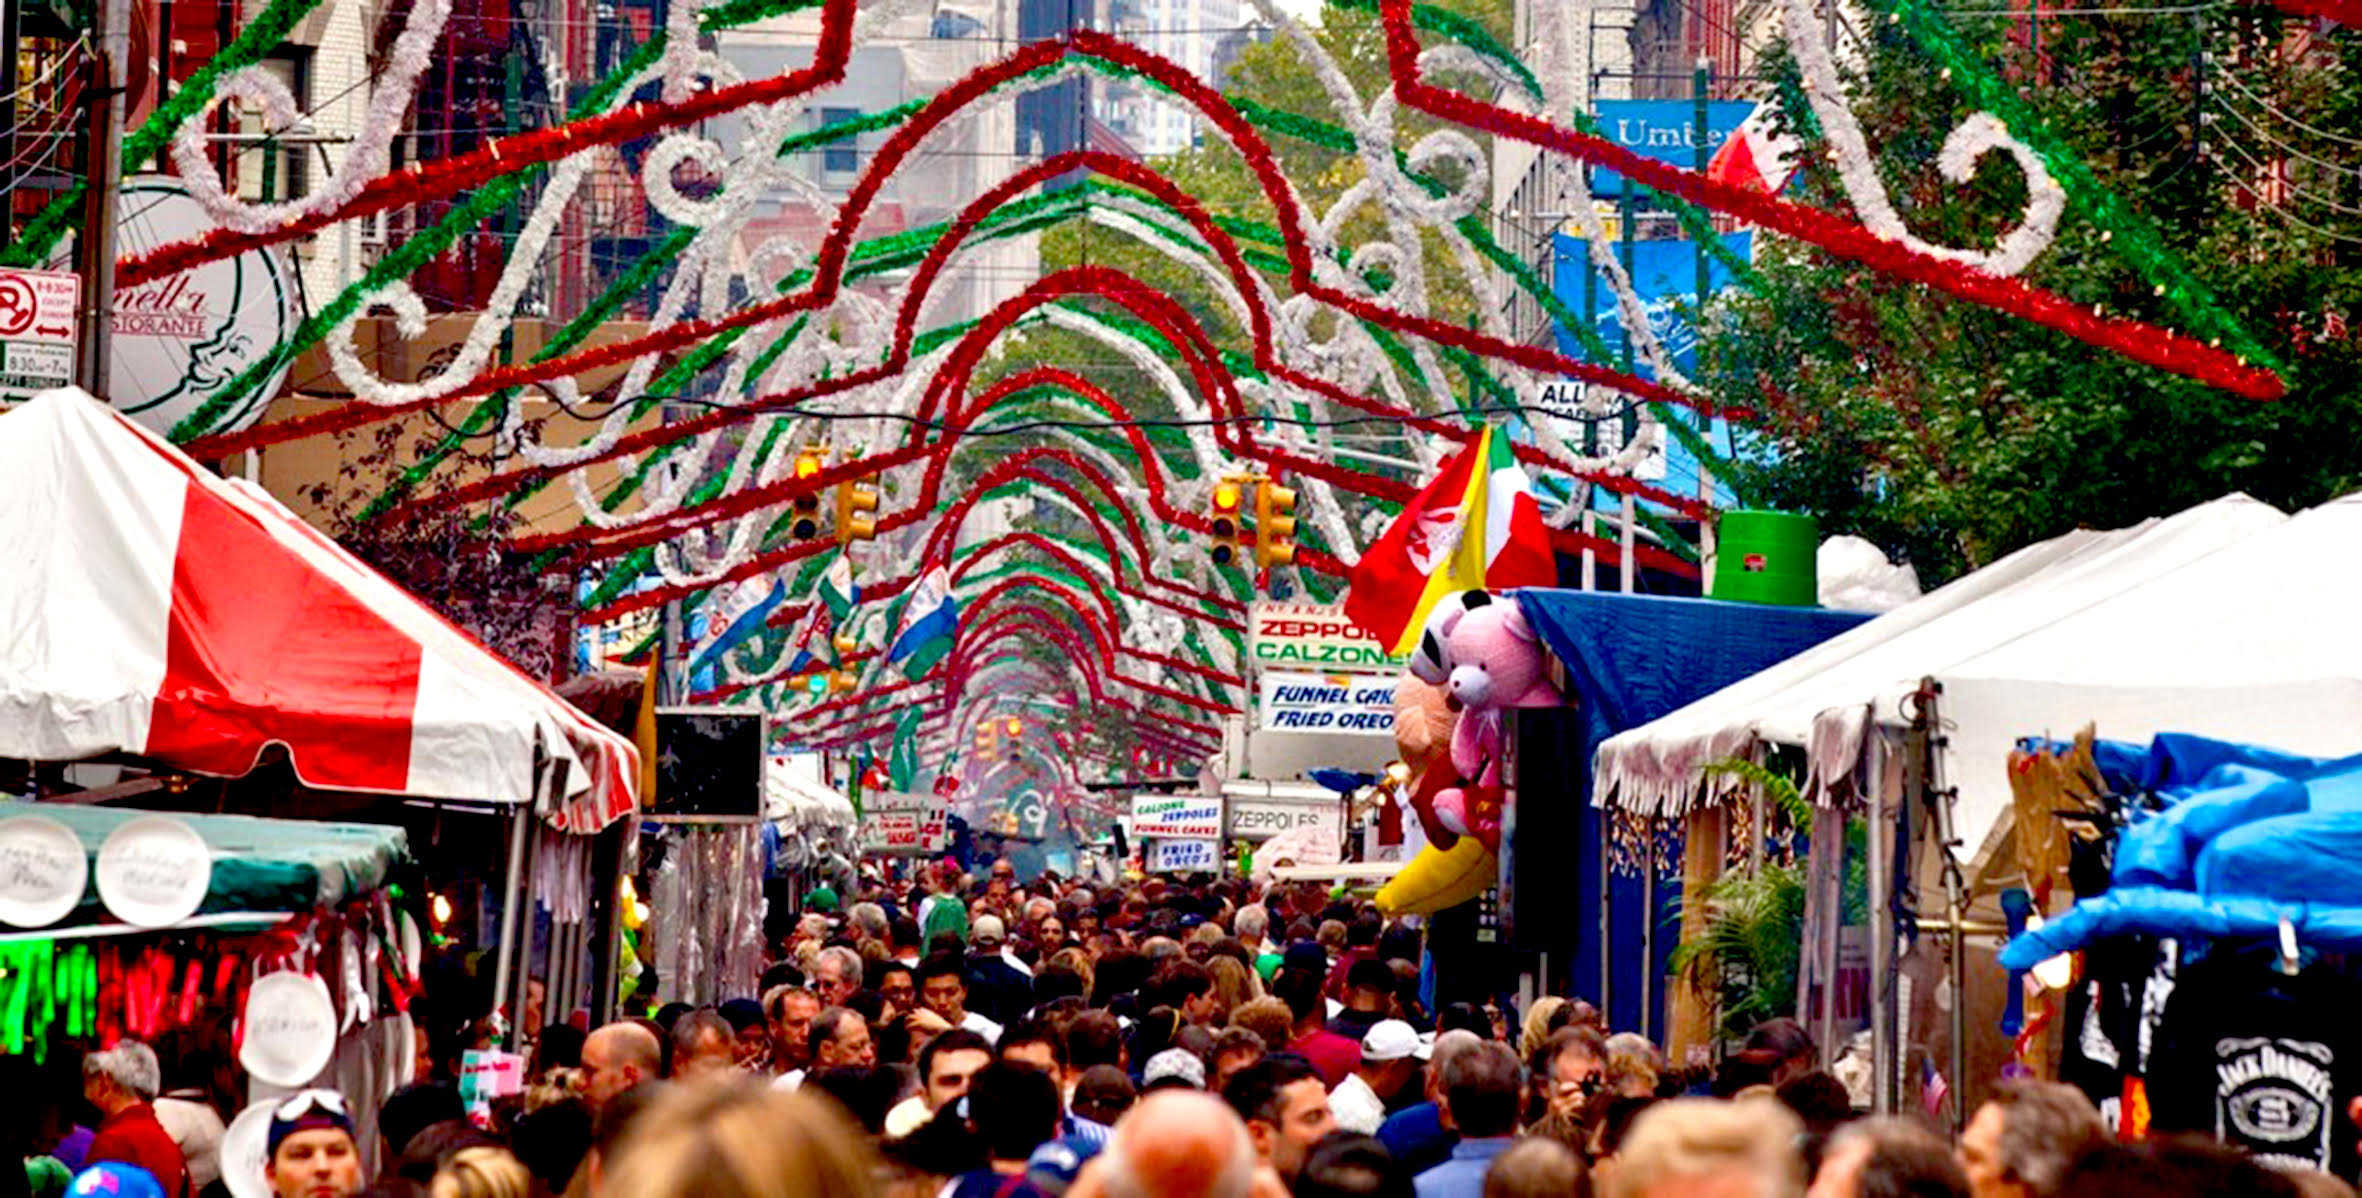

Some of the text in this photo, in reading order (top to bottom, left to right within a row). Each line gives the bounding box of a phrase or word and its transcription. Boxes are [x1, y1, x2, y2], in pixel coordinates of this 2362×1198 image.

[1273, 686, 1349, 704] FUNNEL
[1273, 711, 1394, 729] FRIED OREO
[1161, 807, 1218, 822] ZEPPOLES
[1134, 824, 1218, 834] FUNNEL CAKES
[1162, 843, 1203, 856] FRIED
[2216, 1045, 2334, 1102] JACK DANIEL'S
